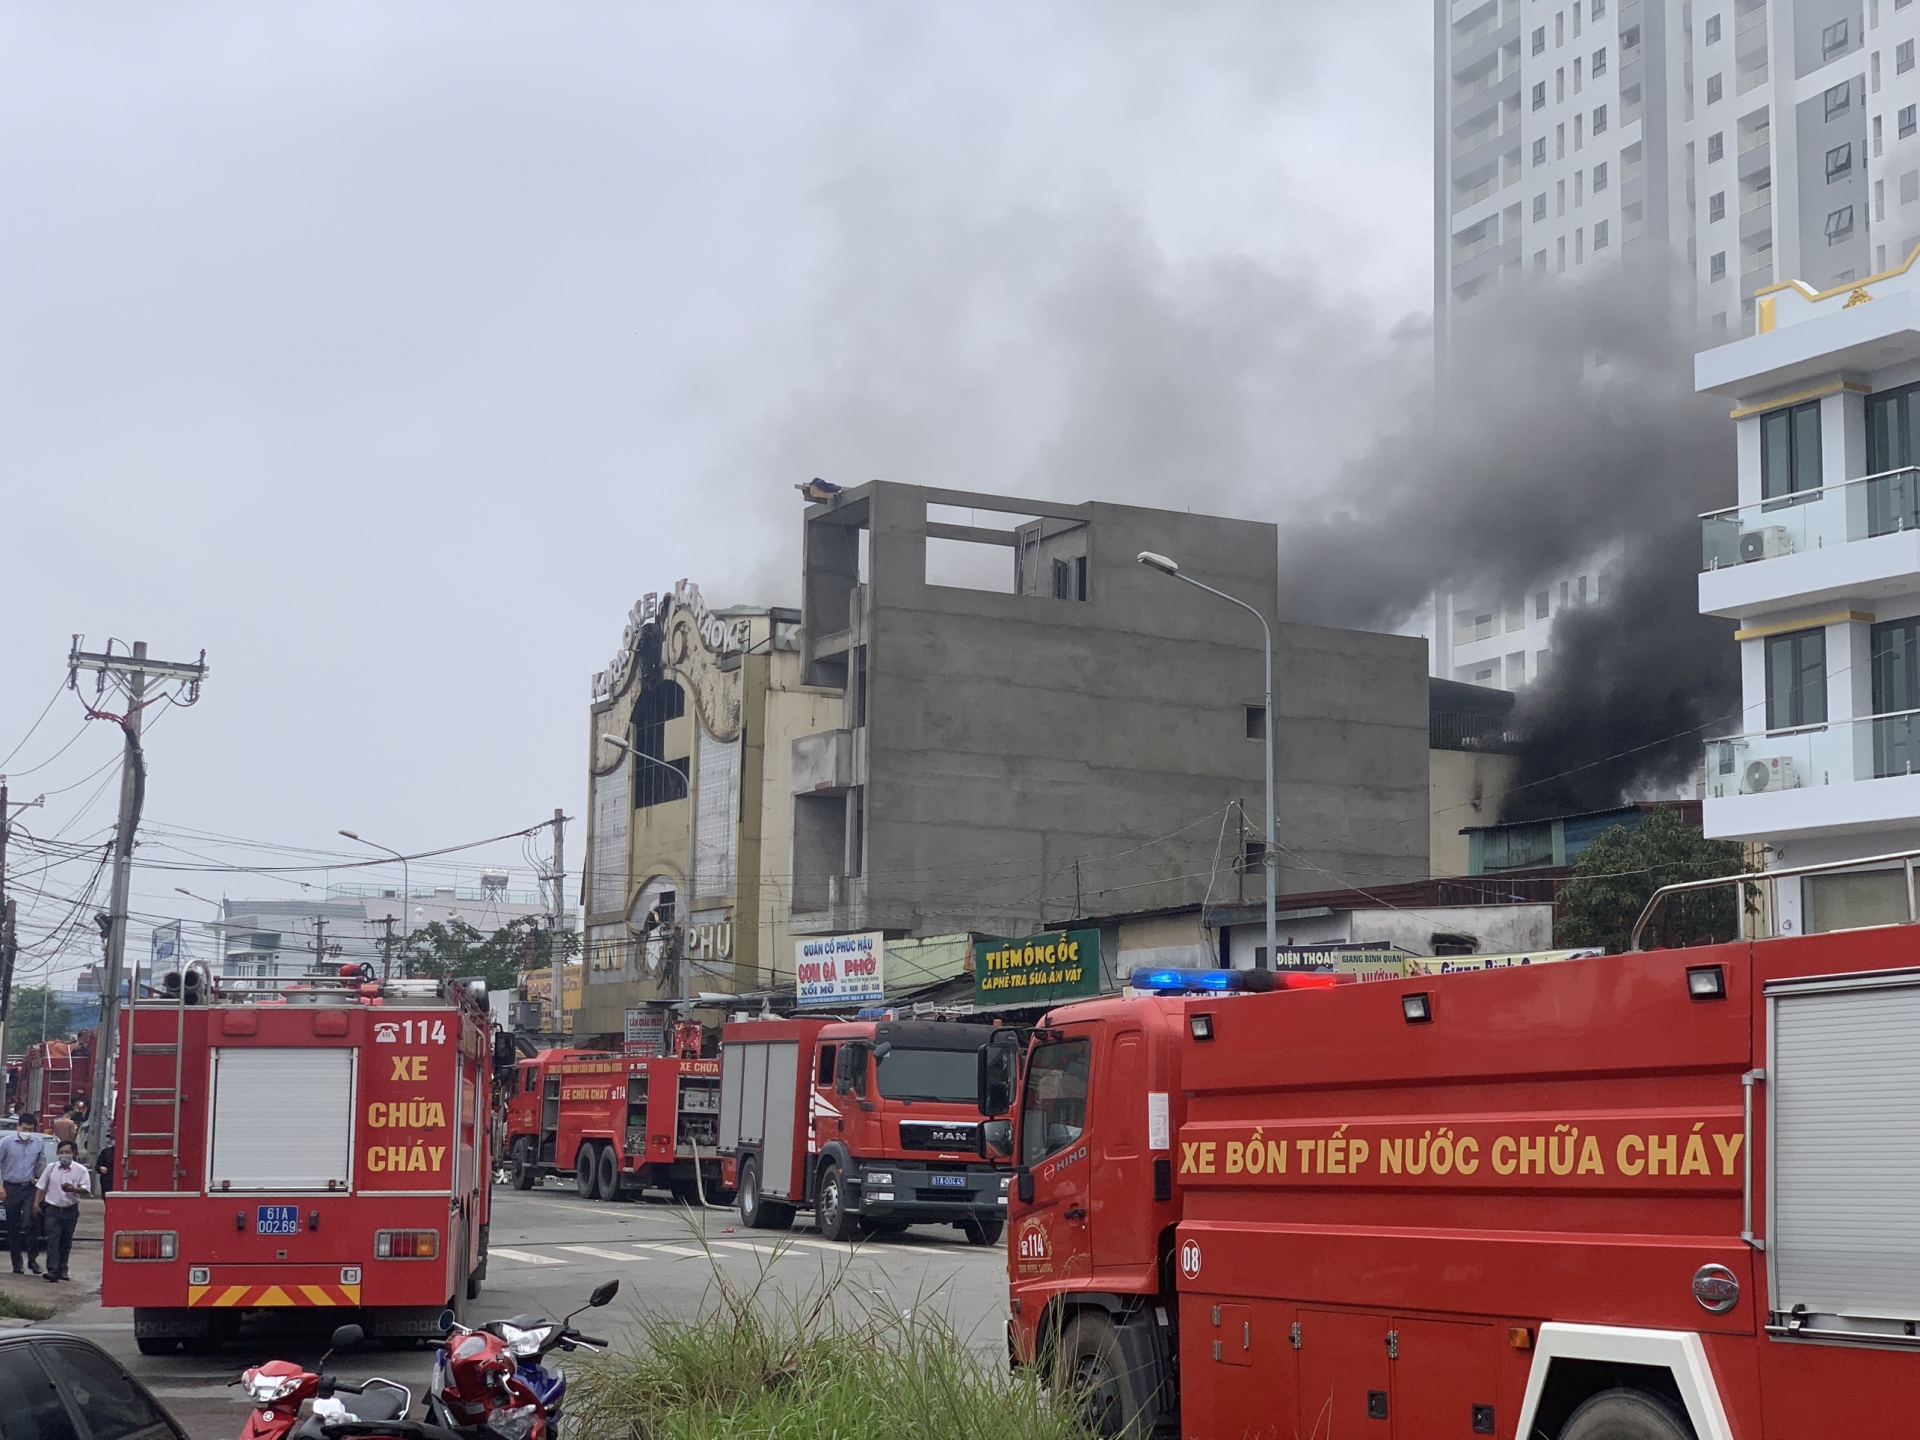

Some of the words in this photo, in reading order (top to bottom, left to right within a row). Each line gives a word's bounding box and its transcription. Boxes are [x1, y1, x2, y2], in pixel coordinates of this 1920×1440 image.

[675, 578, 751, 653] KARAOKE
[591, 592, 658, 699] KARAOKE
[804, 942, 823, 956] QUÁN
[836, 938, 856, 953] PHÚC
[858, 936, 873, 953] HẬU
[1023, 941, 1055, 966] ÔNG
[1057, 932, 1079, 962] ỐC
[823, 957, 838, 982] GÀ
[844, 952, 876, 977] PHỞ
[1276, 950, 1300, 968] ĐIỆN
[1341, 955, 1363, 963] GIANG
[801, 983, 818, 995] XỐI
[402, 1020, 446, 1044] 114
[390, 1056, 428, 1081] XE
[680, 1062, 692, 1071] XE
[693, 1061, 719, 1072] CHỮA
[562, 1089, 571, 1099] XE
[572, 1087, 589, 1099] CHỮA
[591, 1086, 608, 1099] CHÁY
[616, 1086, 626, 1099] 114
[368, 1096, 446, 1128] CHỮA
[932, 1131, 967, 1140] MAN
[367, 1139, 446, 1172] CHÁY
[1056, 1146, 1087, 1171] HINO
[1180, 1142, 1216, 1173] XE
[1225, 1126, 1288, 1174] BỒN
[1296, 1124, 1370, 1173] TIẾP
[1379, 1127, 1479, 1175] NƯỚC
[1491, 1124, 1605, 1175] CHỮA
[1616, 1122, 1744, 1175] CHÁY
[267, 1207, 288, 1220] 61A
[259, 1220, 296, 1233] 002.69
[1028, 1234, 1044, 1256] 114
[1183, 1246, 1199, 1272] 08
[137, 1321, 207, 1333] HYUN
